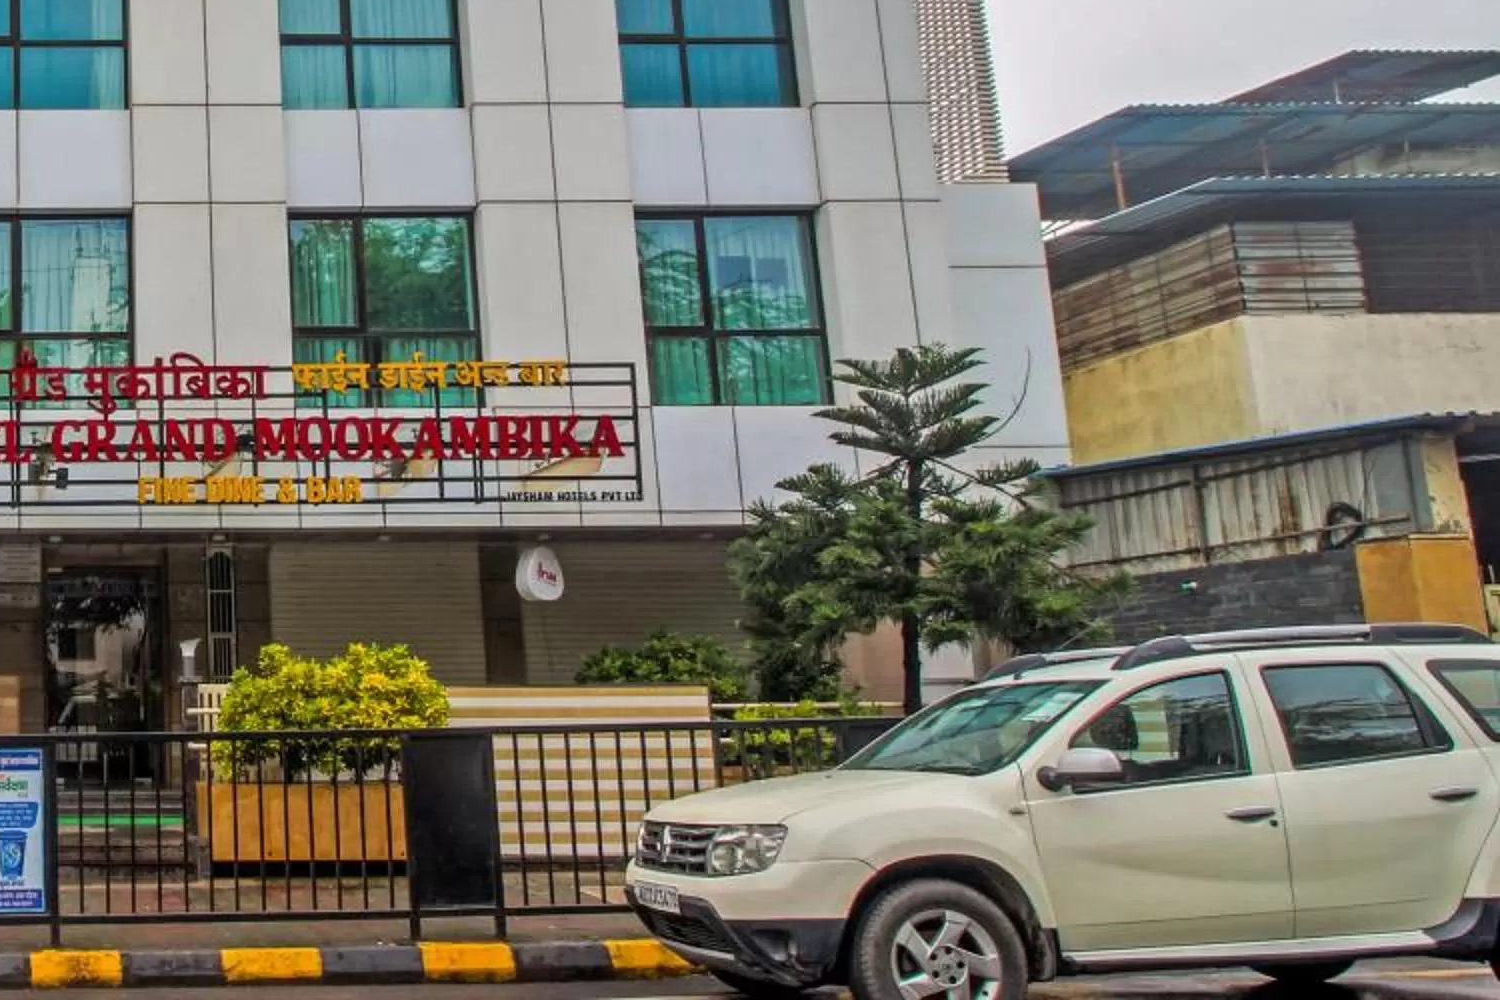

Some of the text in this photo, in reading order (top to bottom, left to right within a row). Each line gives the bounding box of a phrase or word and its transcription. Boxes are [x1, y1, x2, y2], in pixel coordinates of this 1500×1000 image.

[518, 360, 567, 387] बार
[52, 418, 239, 463] GRAND
[255, 414, 626, 463] MOOKAMBIKA
[138, 475, 363, 504] FINE DINE & BAR
[557, 491, 597, 501] HOTELS
[601, 491, 620, 501] PVT
